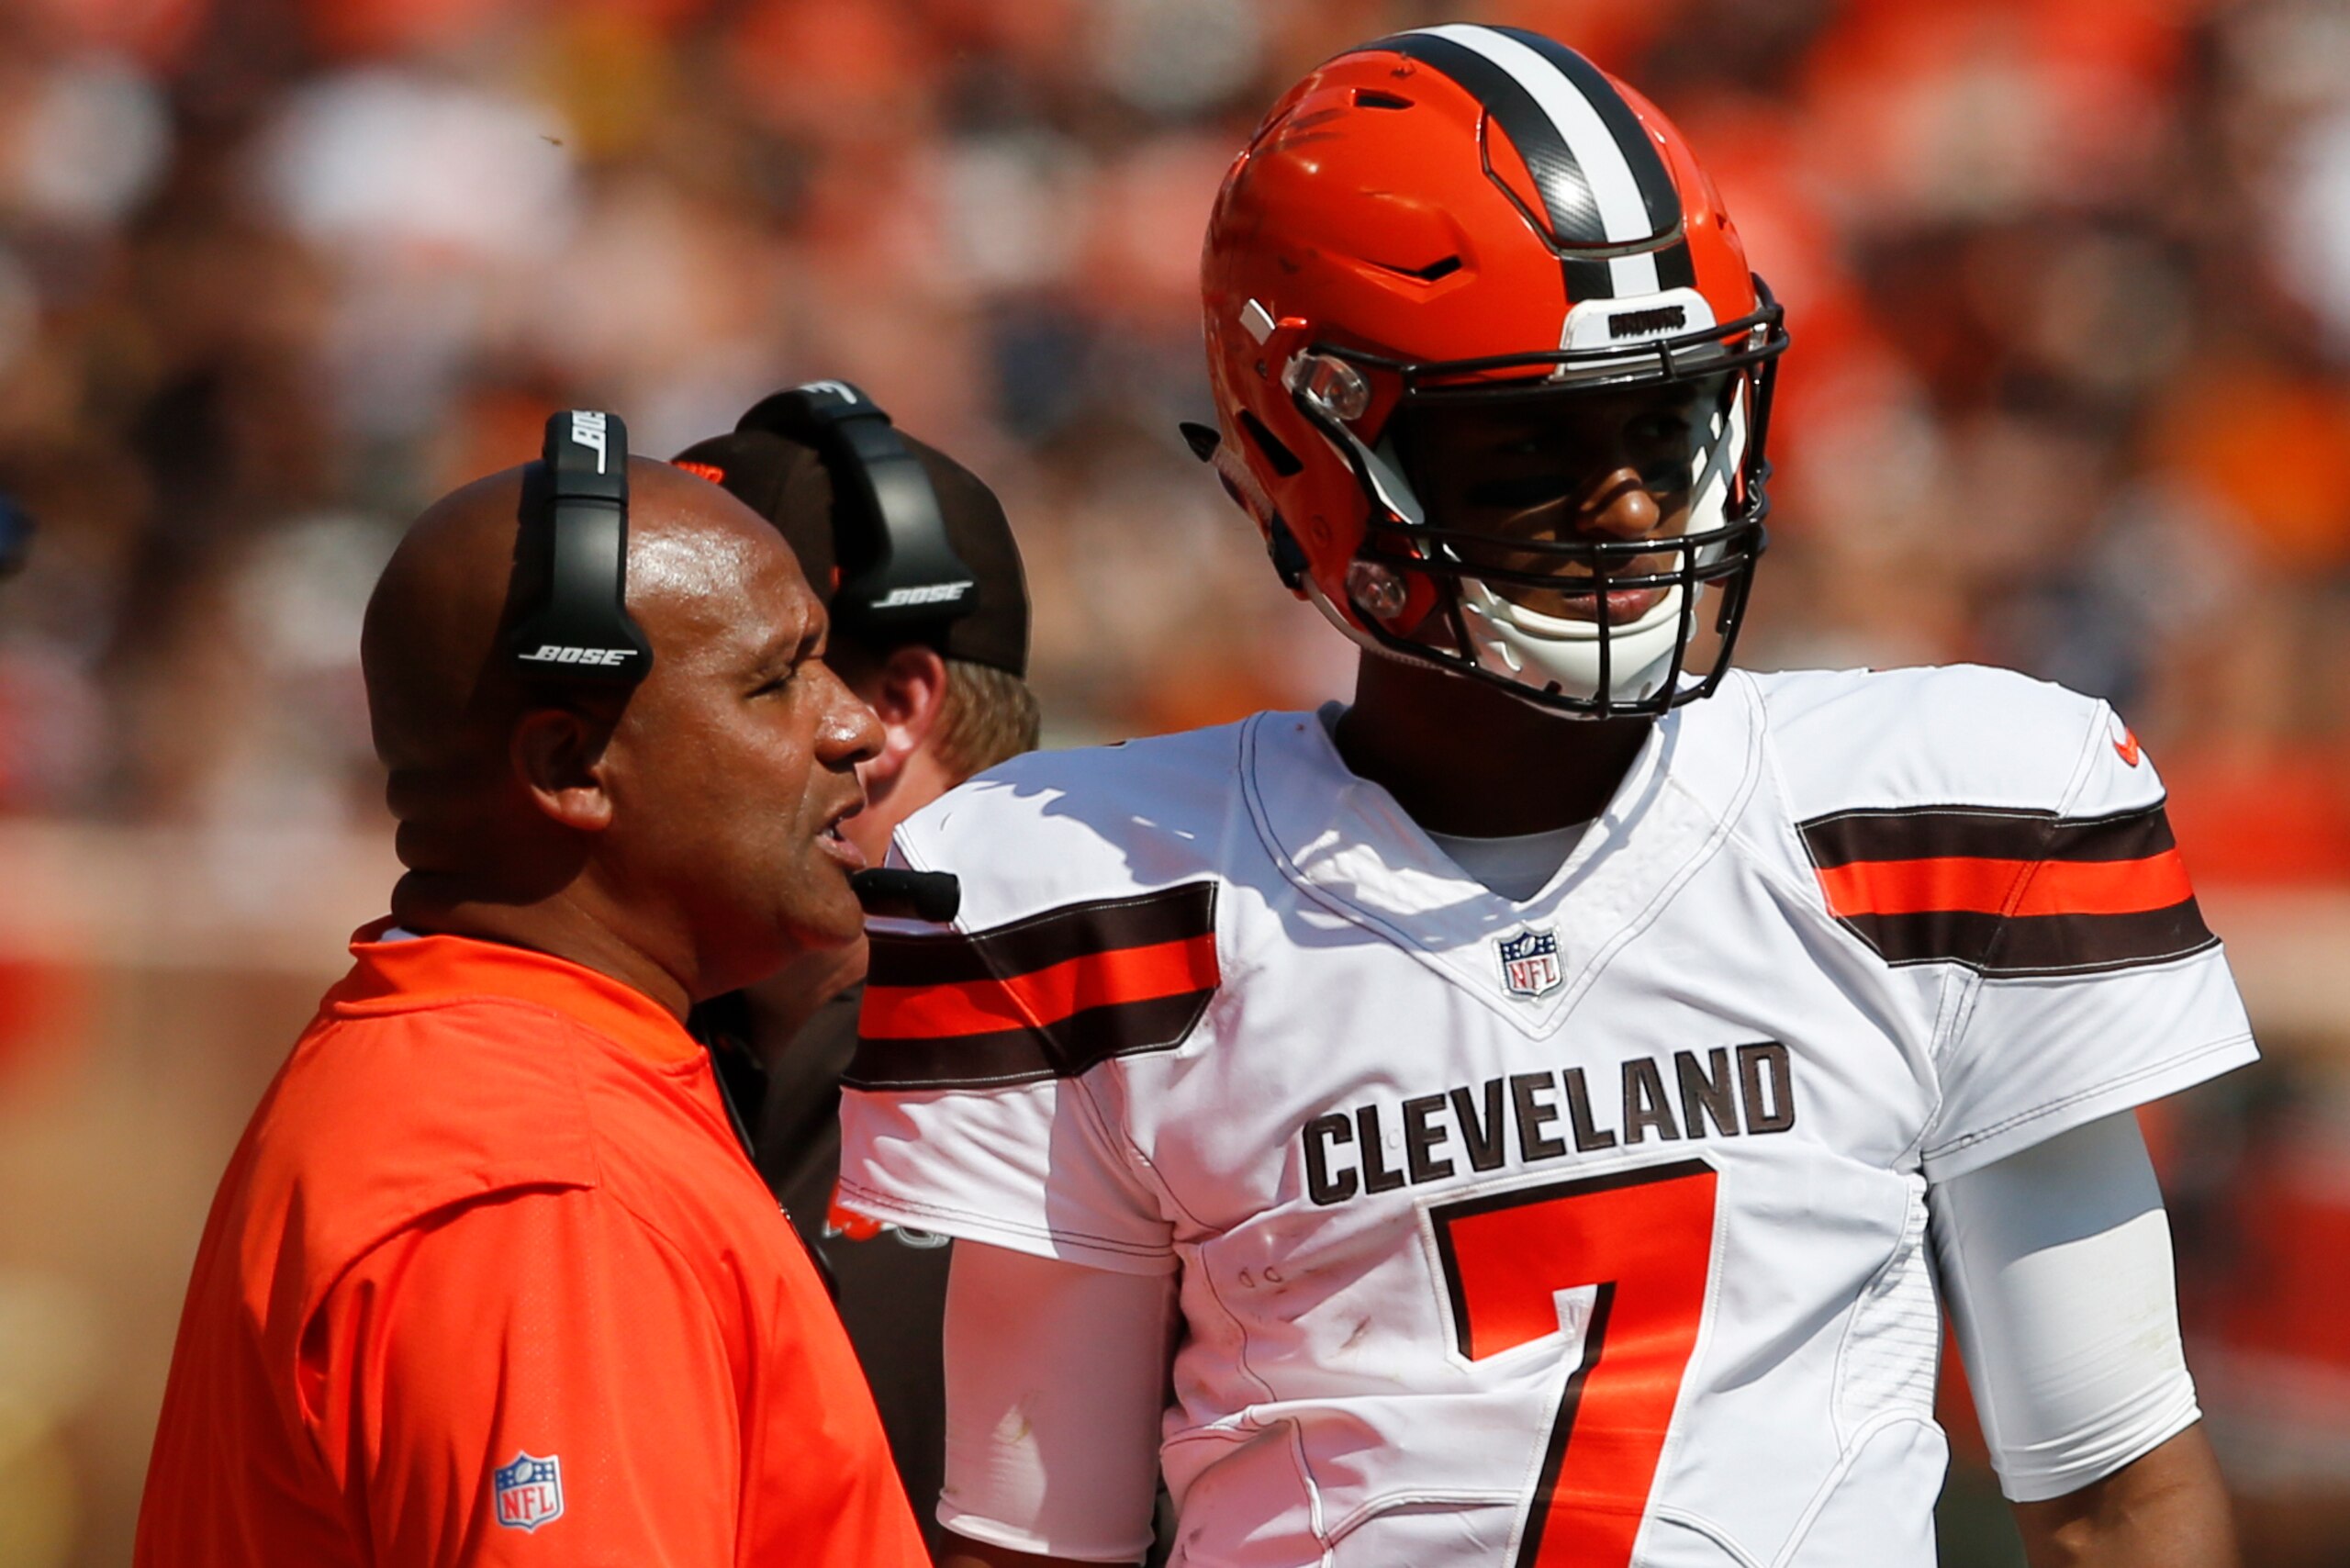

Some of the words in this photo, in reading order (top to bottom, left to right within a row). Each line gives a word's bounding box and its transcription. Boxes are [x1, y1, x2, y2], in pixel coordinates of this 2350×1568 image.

[871, 580, 974, 608] BOSE
[518, 644, 638, 666] BOSE
[1508, 958, 1557, 991] NFL
[1302, 1041, 1796, 1206] CLEVELAND
[1427, 1157, 1718, 1568] 7
[501, 1485, 554, 1520] NFL
